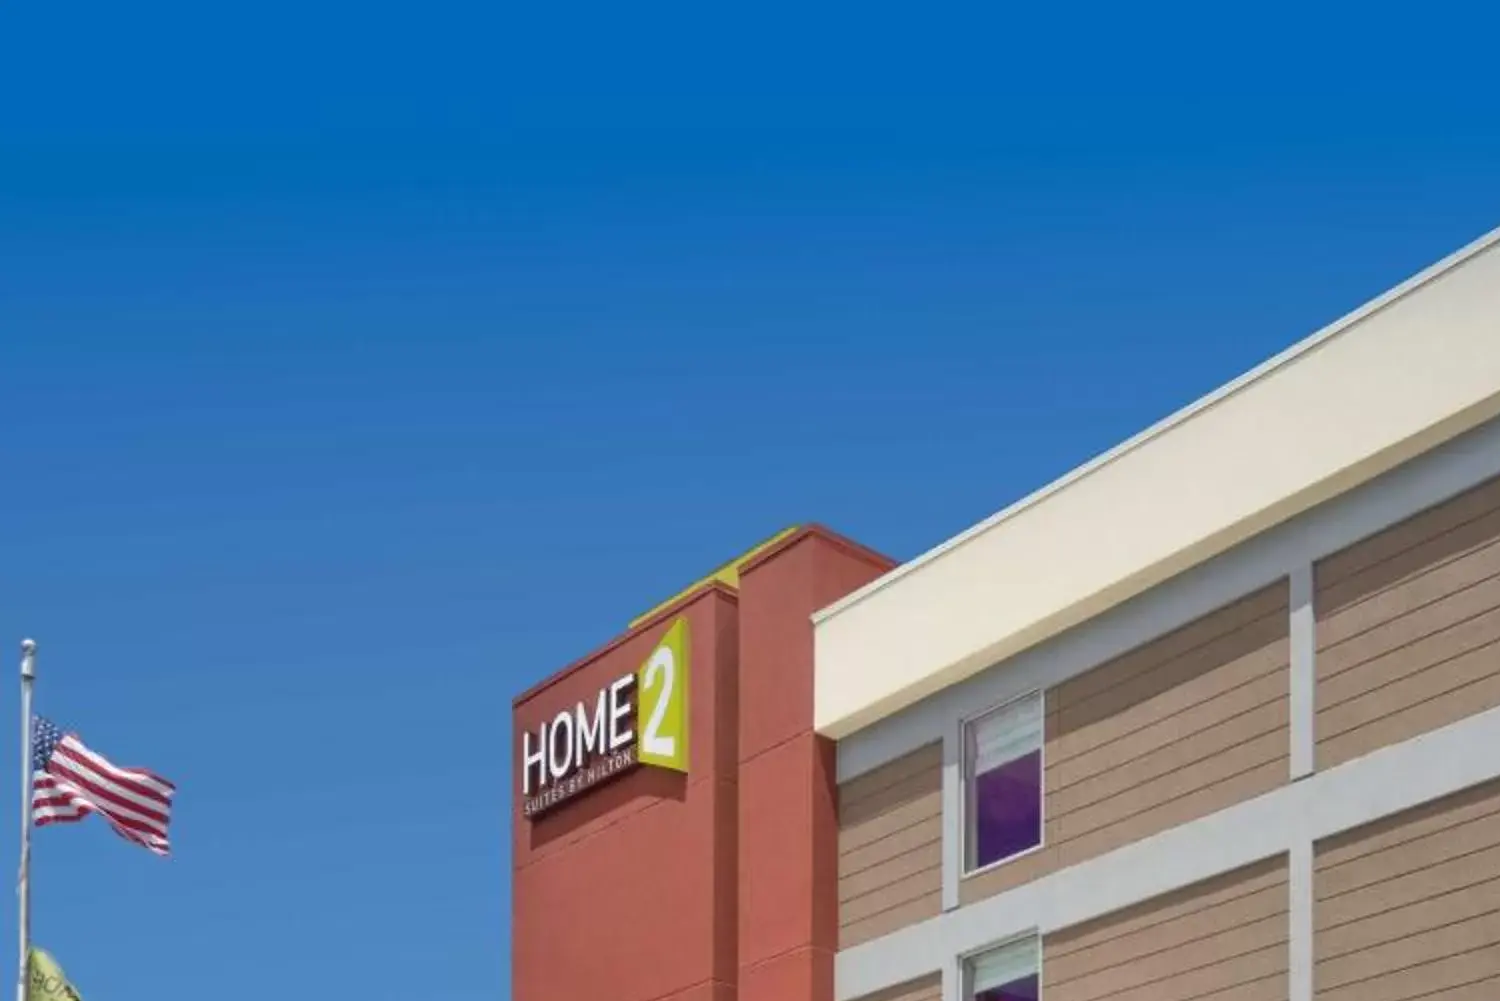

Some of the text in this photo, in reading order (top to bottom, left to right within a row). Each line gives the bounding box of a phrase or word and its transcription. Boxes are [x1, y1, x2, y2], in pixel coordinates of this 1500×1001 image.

[523, 645, 675, 794] HOME 2
[525, 750, 631, 815] SUITES BY HILTON
